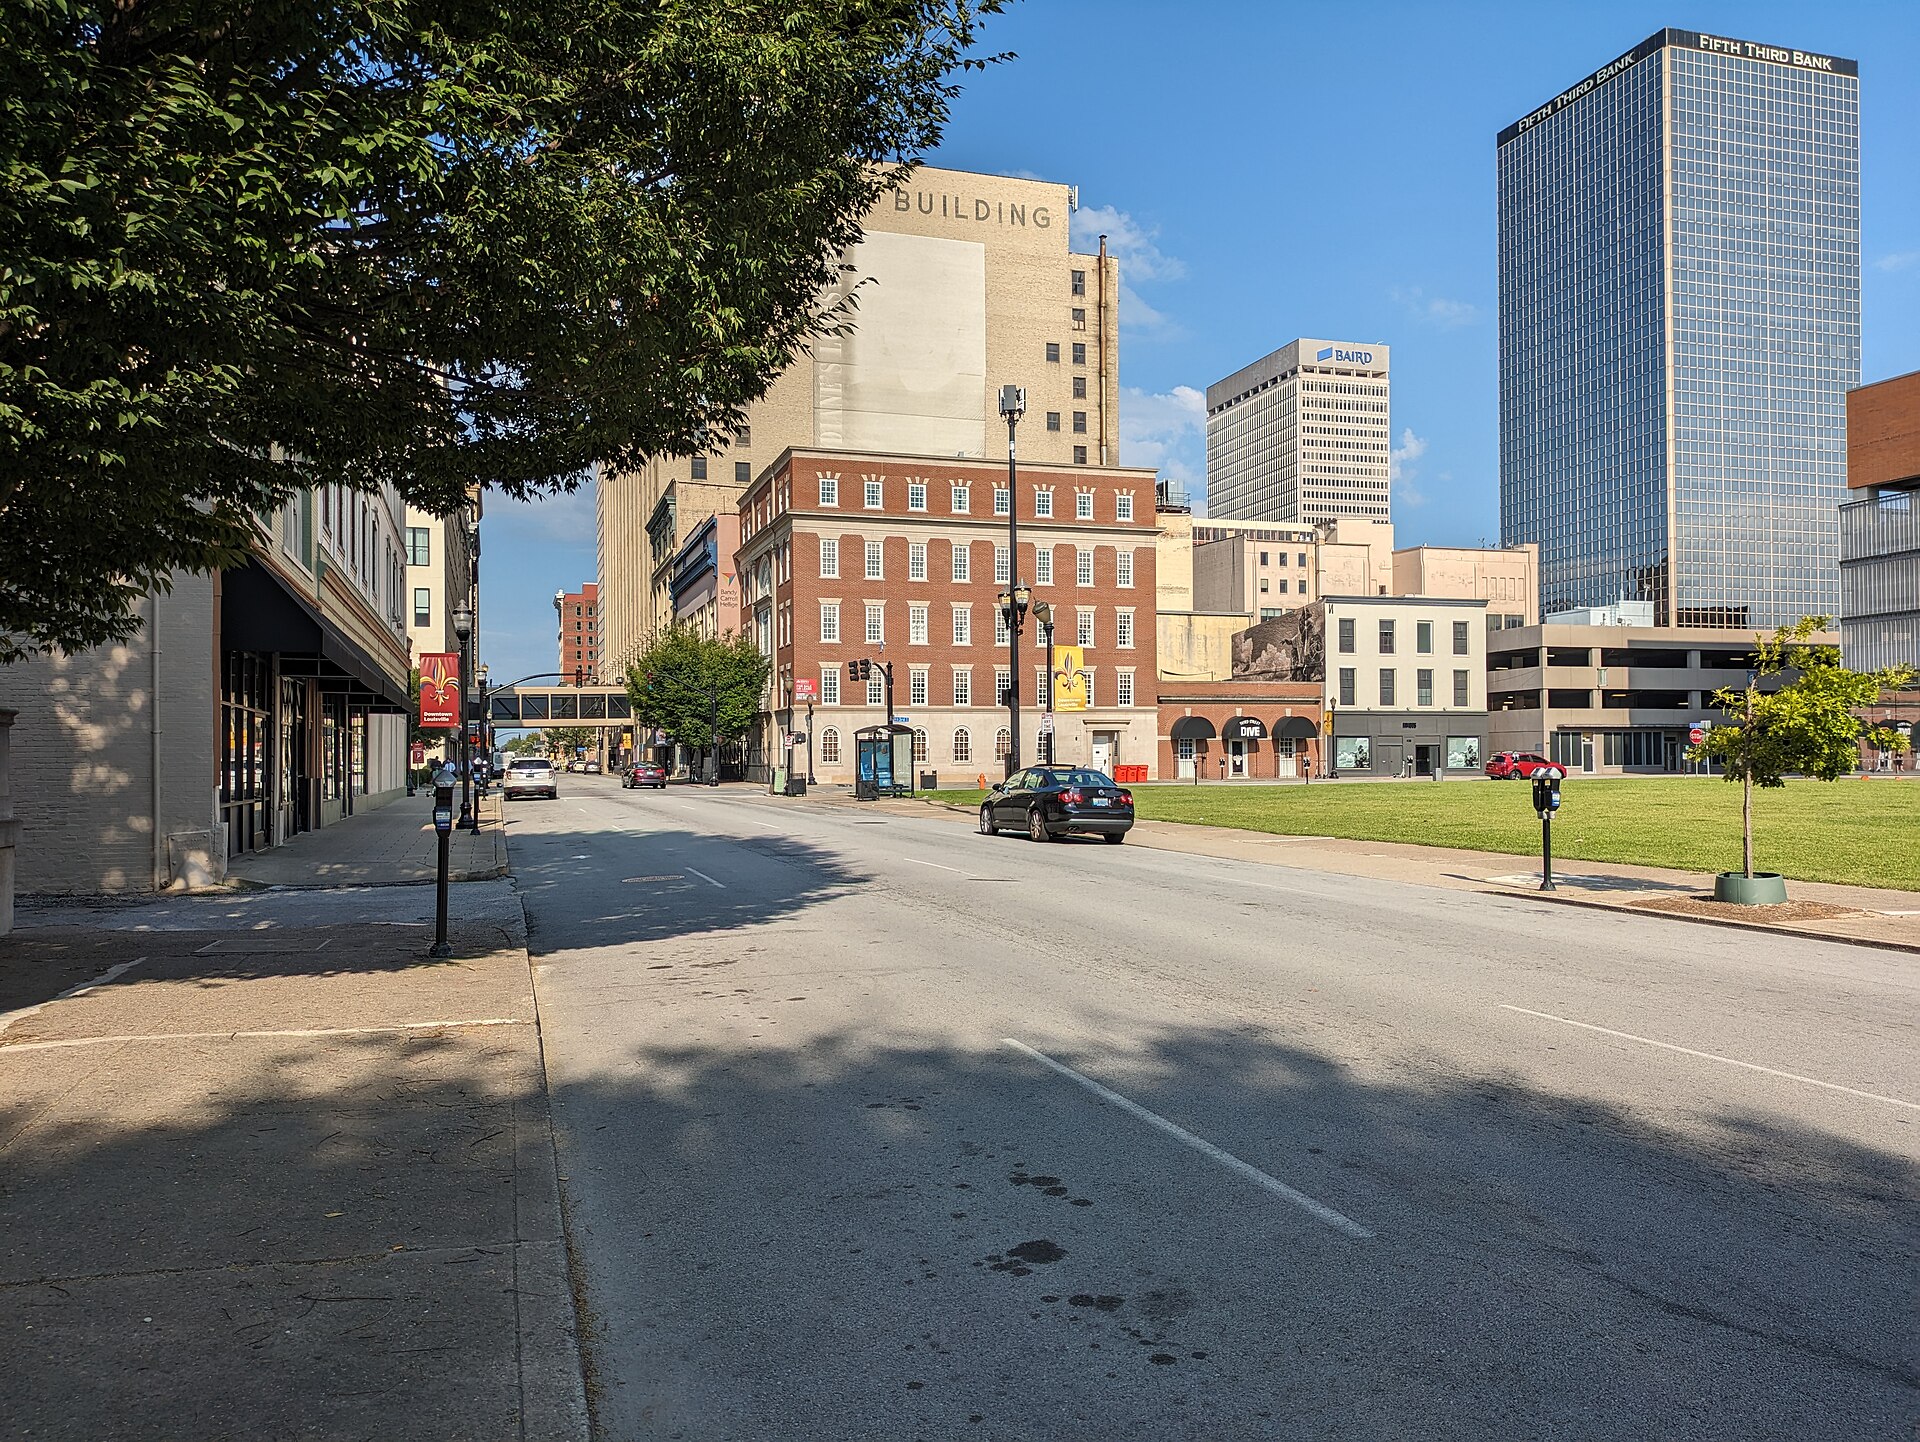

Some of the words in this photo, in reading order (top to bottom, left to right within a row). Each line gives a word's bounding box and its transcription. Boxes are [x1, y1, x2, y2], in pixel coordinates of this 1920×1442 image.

[1699, 34, 1741, 55] FIFTH
[1744, 42, 1789, 63] THIRD
[1792, 51, 1832, 71] BANK
[1518, 103, 1553, 133] FIFTH
[1553, 79, 1594, 109] THIRD
[1596, 51, 1636, 84] BANK
[894, 188, 1051, 229] BUILDING
[1334, 349, 1373, 365] BAIRD
[720, 588, 738, 596] Bandy
[1240, 726, 1260, 737] DIVE
